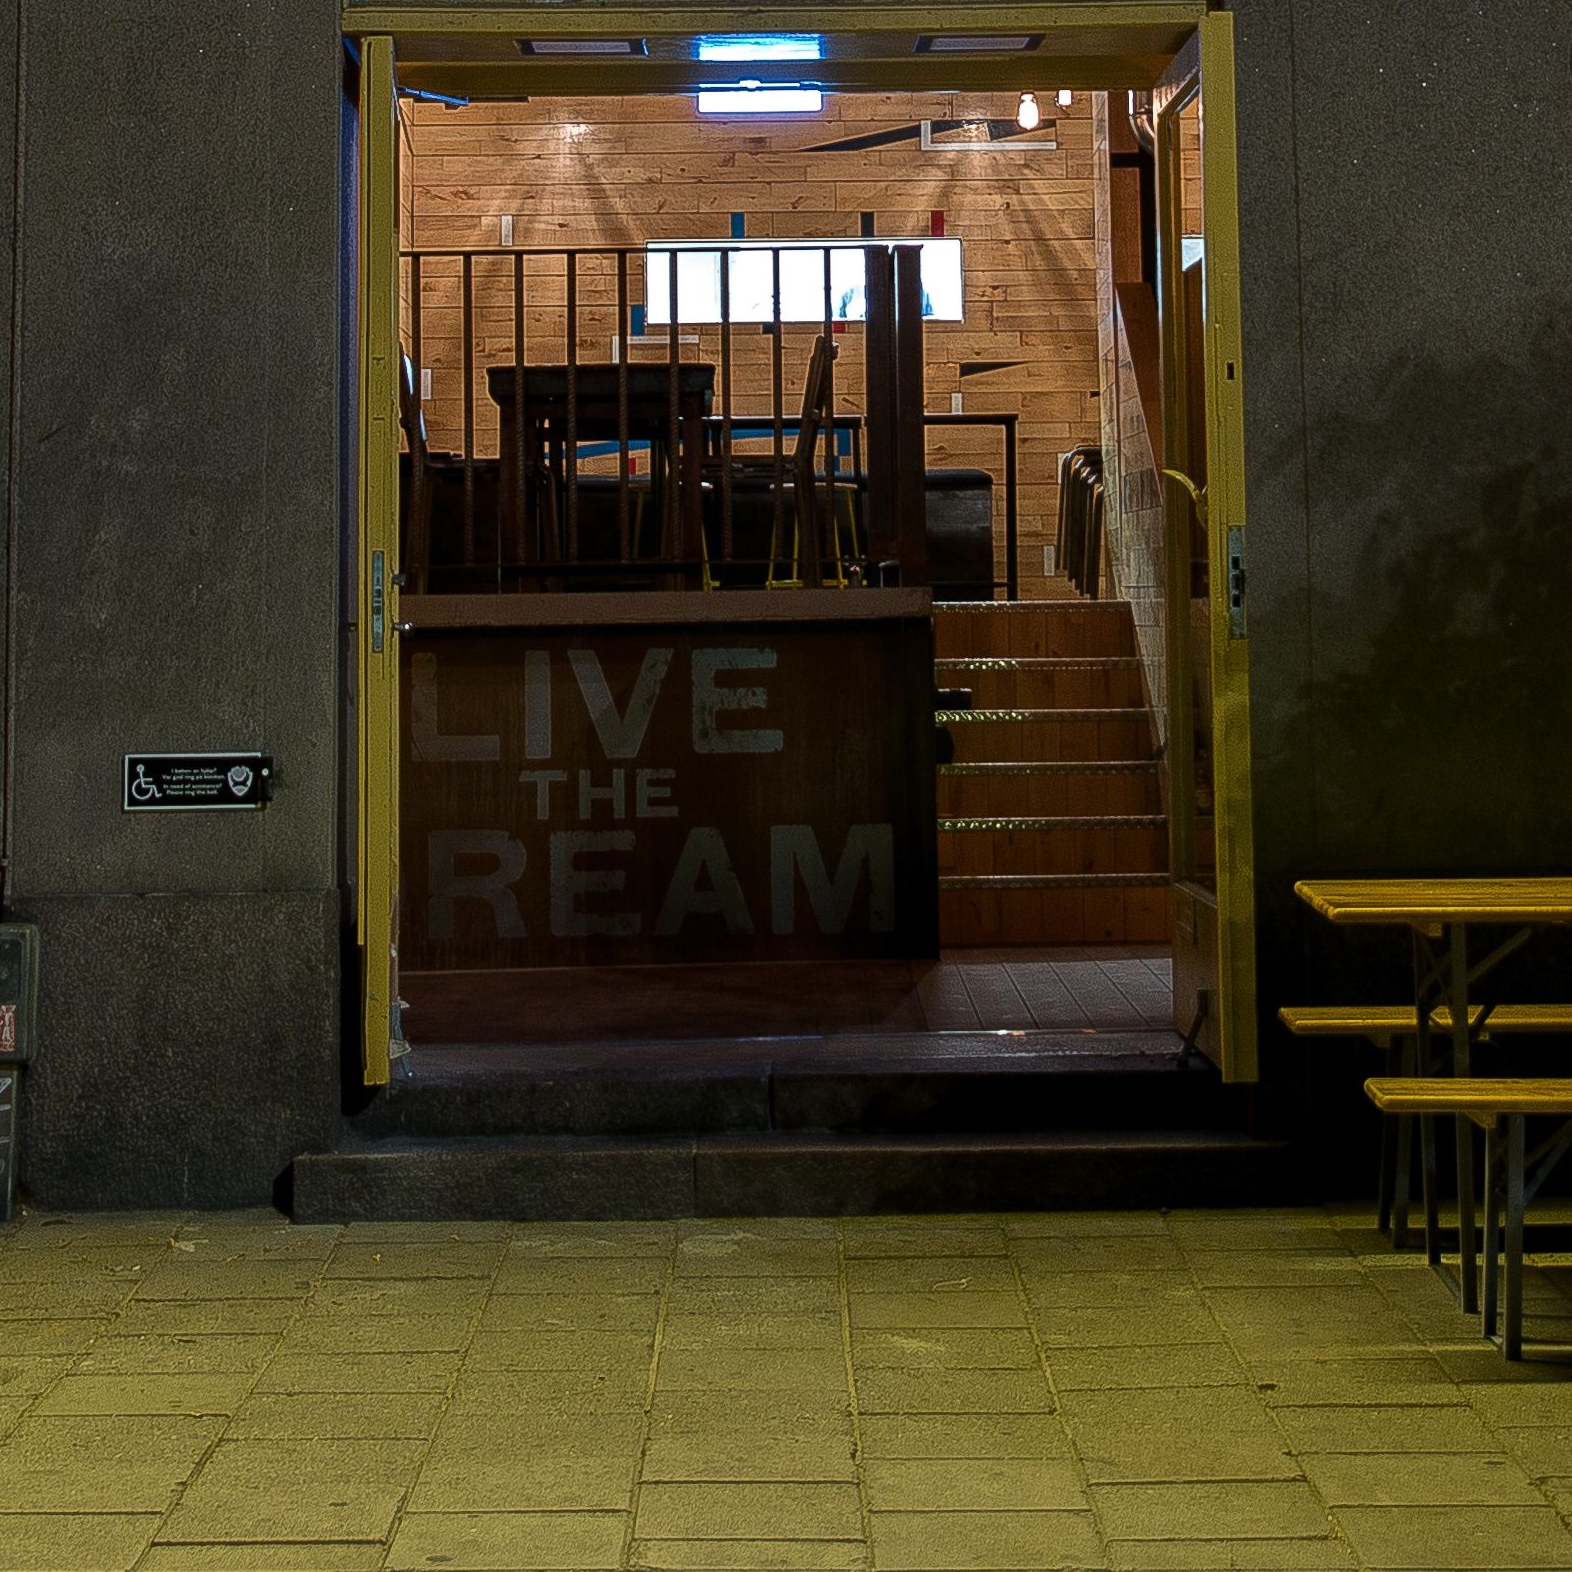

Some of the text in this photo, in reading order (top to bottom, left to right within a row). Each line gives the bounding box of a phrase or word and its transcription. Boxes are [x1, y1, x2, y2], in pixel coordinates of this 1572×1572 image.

[411, 647, 784, 762] LIVE
[519, 767, 679, 821] THE
[426, 823, 895, 940] REAM
